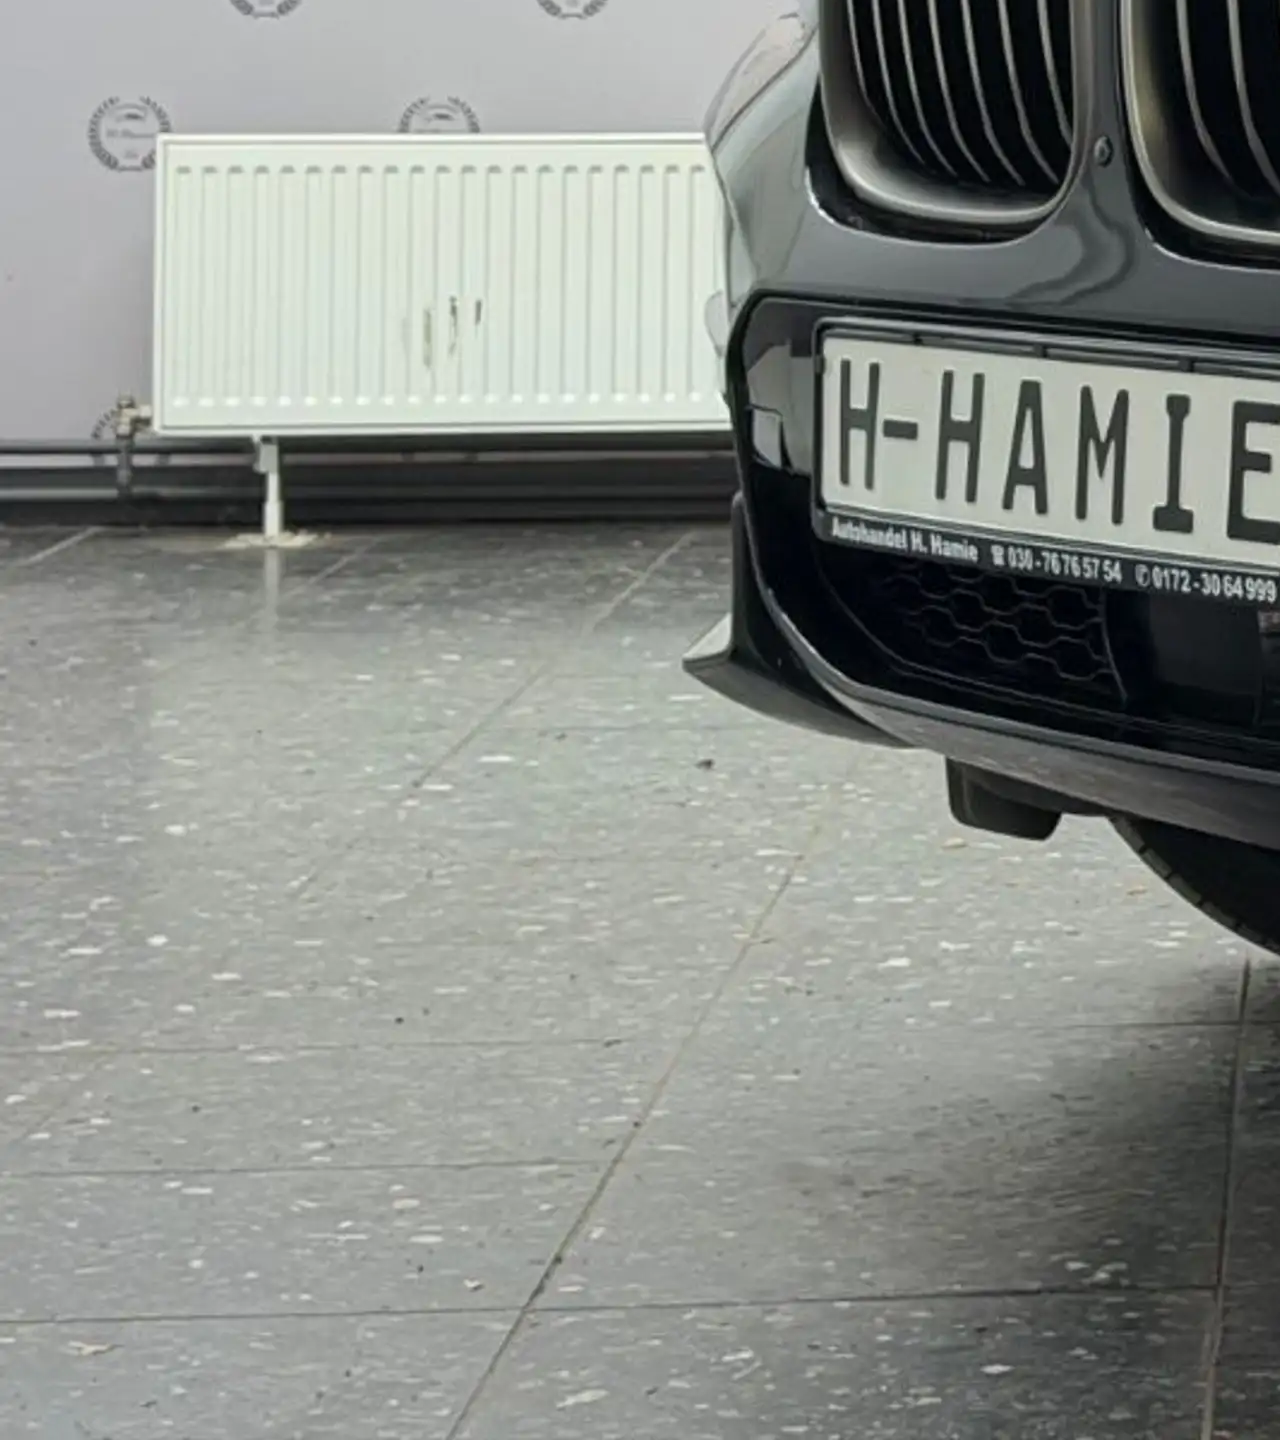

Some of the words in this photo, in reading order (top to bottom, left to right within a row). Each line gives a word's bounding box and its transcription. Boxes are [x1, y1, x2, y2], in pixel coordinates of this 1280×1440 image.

[831, 516, 907, 551] Autohandel
[910, 529, 928, 554] H.
[930, 533, 979, 565] Hamie
